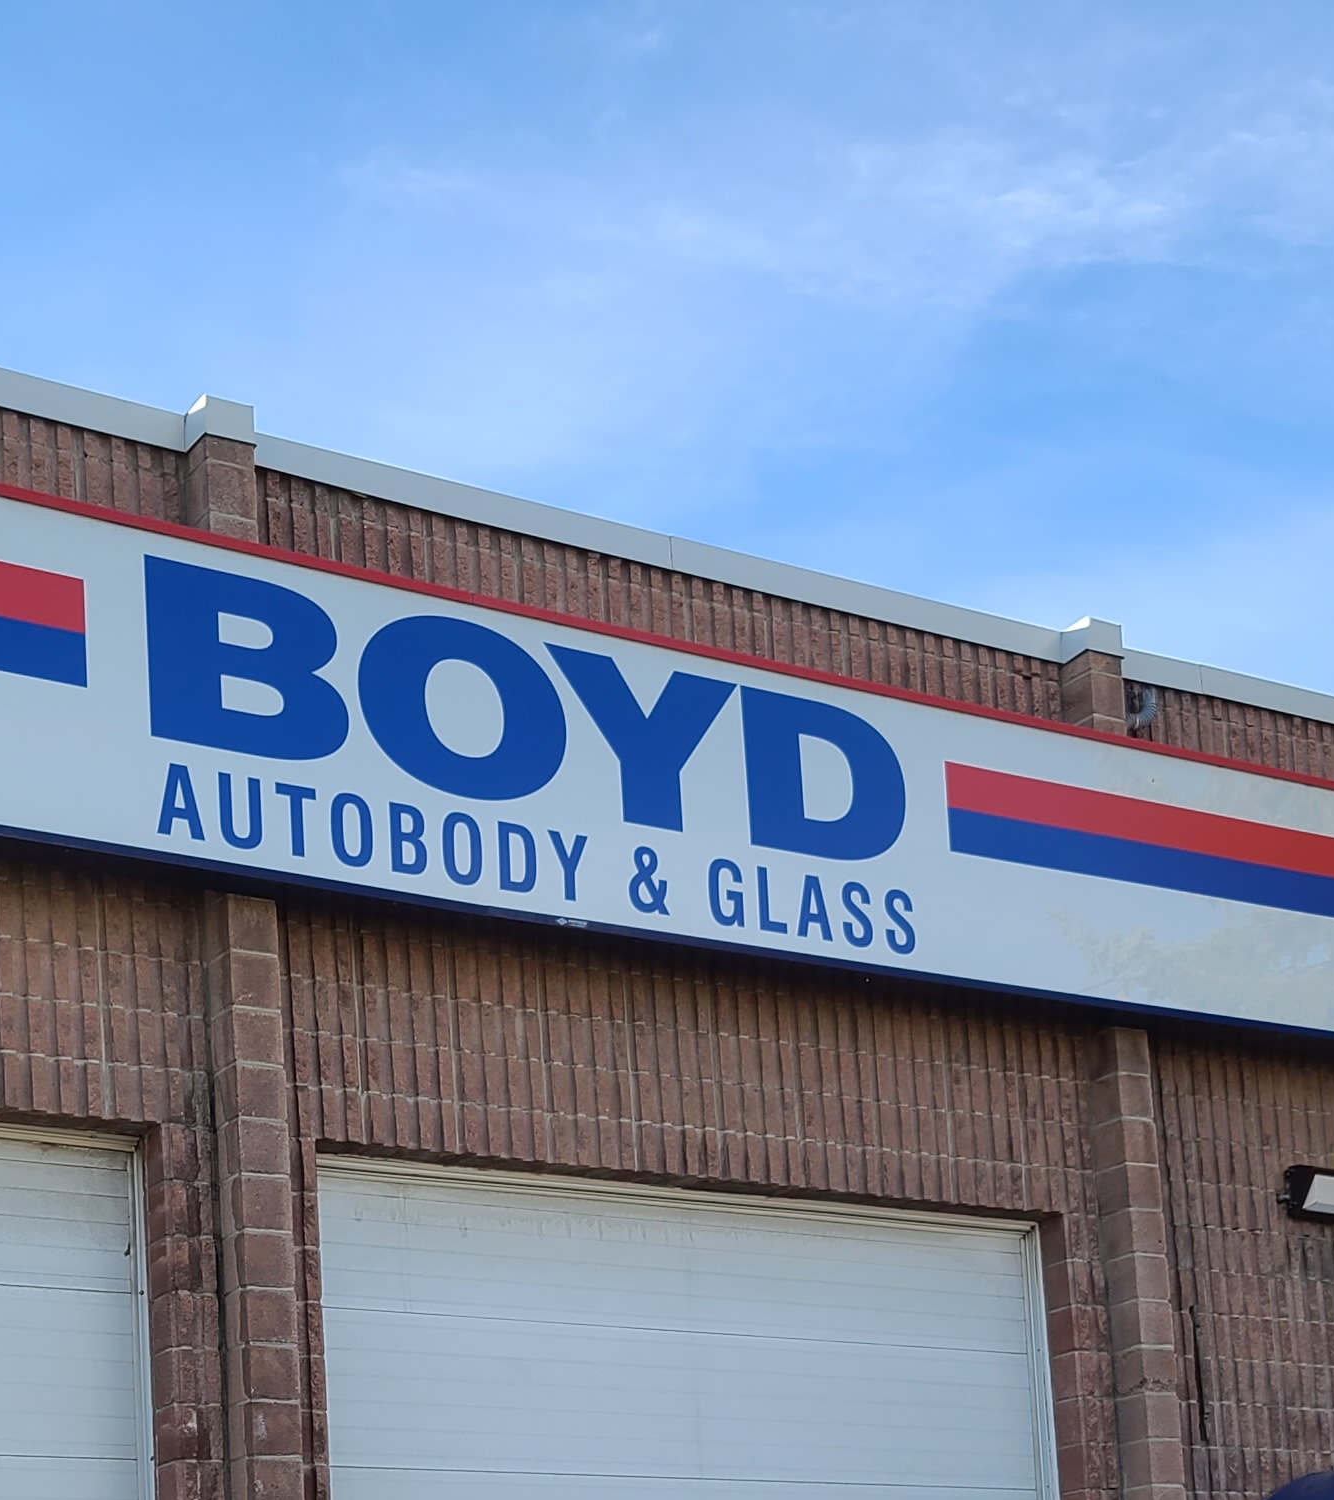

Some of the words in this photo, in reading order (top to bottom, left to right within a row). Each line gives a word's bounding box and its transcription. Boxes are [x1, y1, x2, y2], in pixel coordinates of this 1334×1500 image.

[143, 553, 906, 861] BOYD
[157, 762, 588, 902] AUTOBODY
[628, 845, 670, 917] &
[708, 858, 916, 956] GLASS
